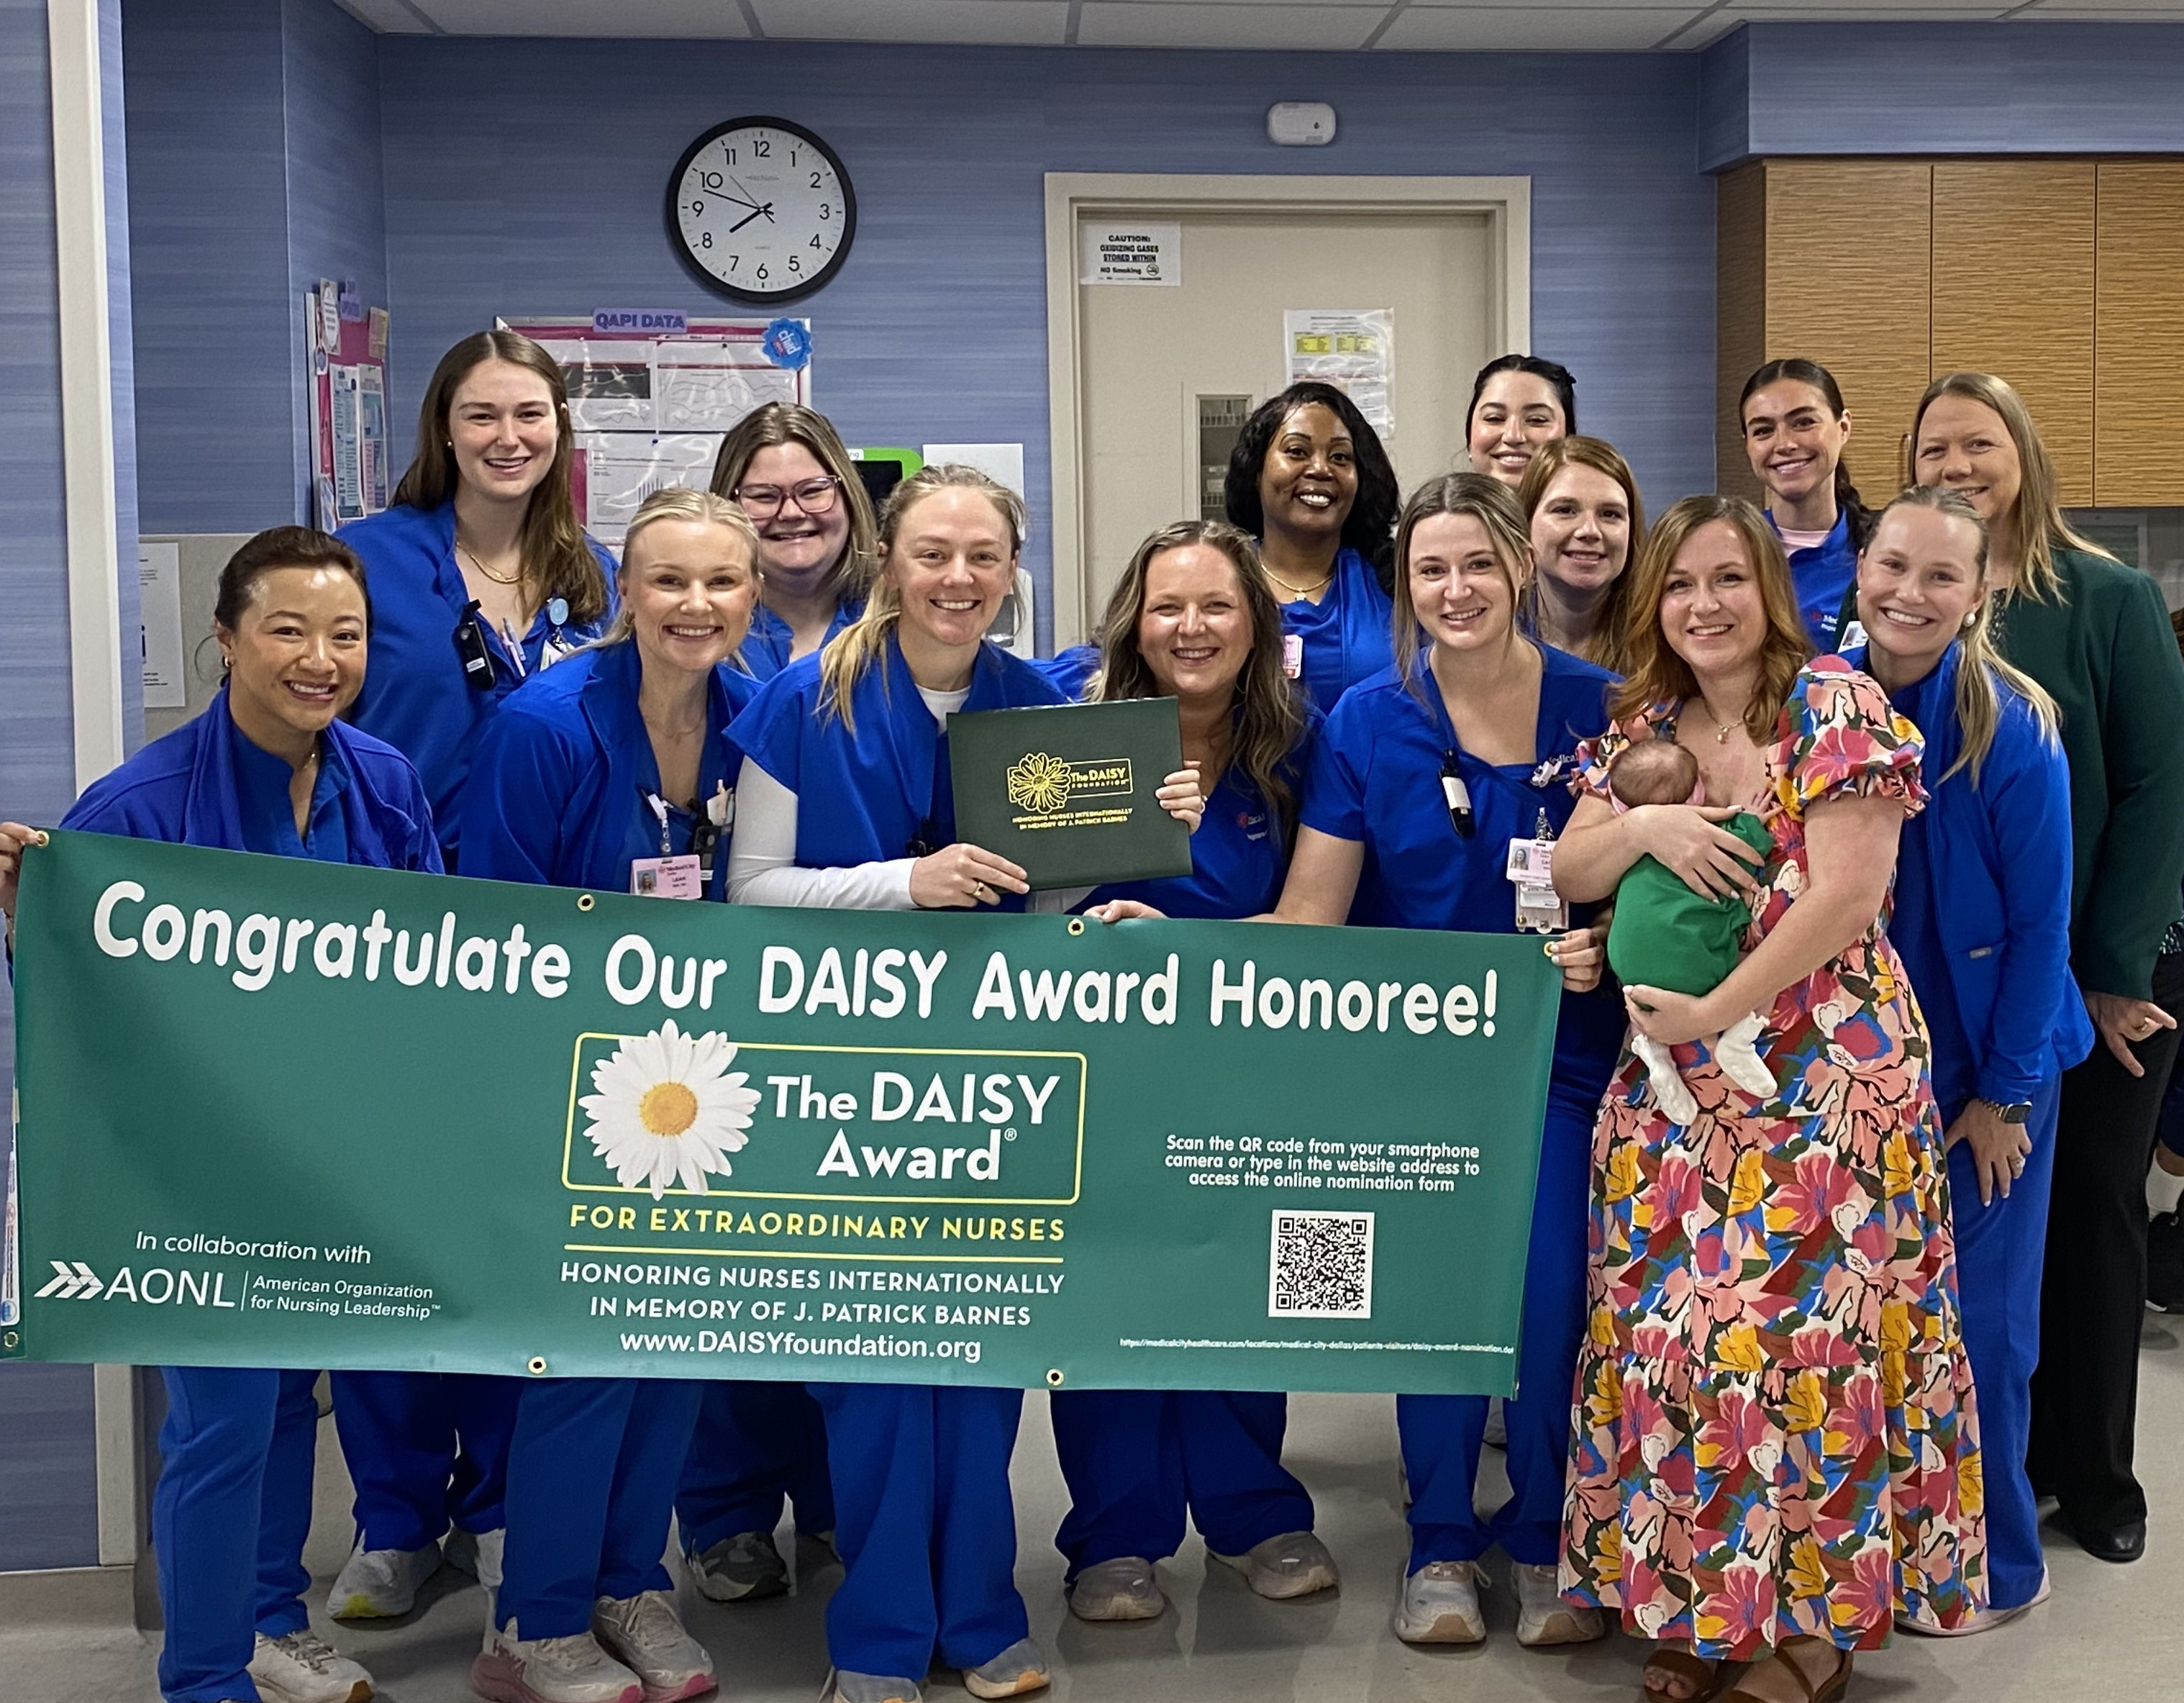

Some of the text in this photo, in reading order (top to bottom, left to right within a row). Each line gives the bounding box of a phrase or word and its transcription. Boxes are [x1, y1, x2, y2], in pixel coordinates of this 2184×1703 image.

[724, 148, 736, 165] 11
[754, 141, 770, 158] 12
[791, 151, 796, 167] 1
[700, 171, 724, 189] 10
[810, 172, 822, 189] 2
[692, 201, 704, 217] 9
[819, 204, 830, 219] 3
[702, 232, 712, 249] 8
[809, 234, 822, 250] 4
[729, 255, 740, 271] 7
[757, 263, 768, 280] 6
[788, 255, 800, 272] 5
[596, 313, 684, 330] QAPI DATA
[1070, 767, 1126, 783] The DAISY
[1027, 821, 1056, 830] MEMORY
[1075, 817, 1101, 826] PATRICK
[1102, 815, 1128, 824] BARNES
[1049, 812, 1075, 821] NURSES
[1075, 808, 1133, 819] INTERNATIONALLY
[94, 881, 1498, 1037] Congratulate Our DAISY Award Honoree!
[767, 1071, 1061, 1125] The DAISY
[1166, 1134, 1480, 1161] Scan the QR code from your smartphone
[1165, 1154, 1480, 1176] camera or type in the website address to
[1188, 1172, 1455, 1191] access the online nomination form
[570, 1204, 1065, 1242] FOR EXTRAORDINARY NURSES
[136, 1231, 371, 1264] In collaboration with
[560, 1261, 1065, 1294] HONORING NURSES INTERNATIONALLY
[104, 1266, 235, 1308] AONL
[252, 1275, 433, 1299] American Organization
[250, 1295, 273, 1309] for
[276, 1296, 340, 1317] Nursing
[590, 1296, 1032, 1326] IN MEMORY OF J. PATRICK BARNES
[619, 1330, 981, 1363] www.DAISYfoundation.org
